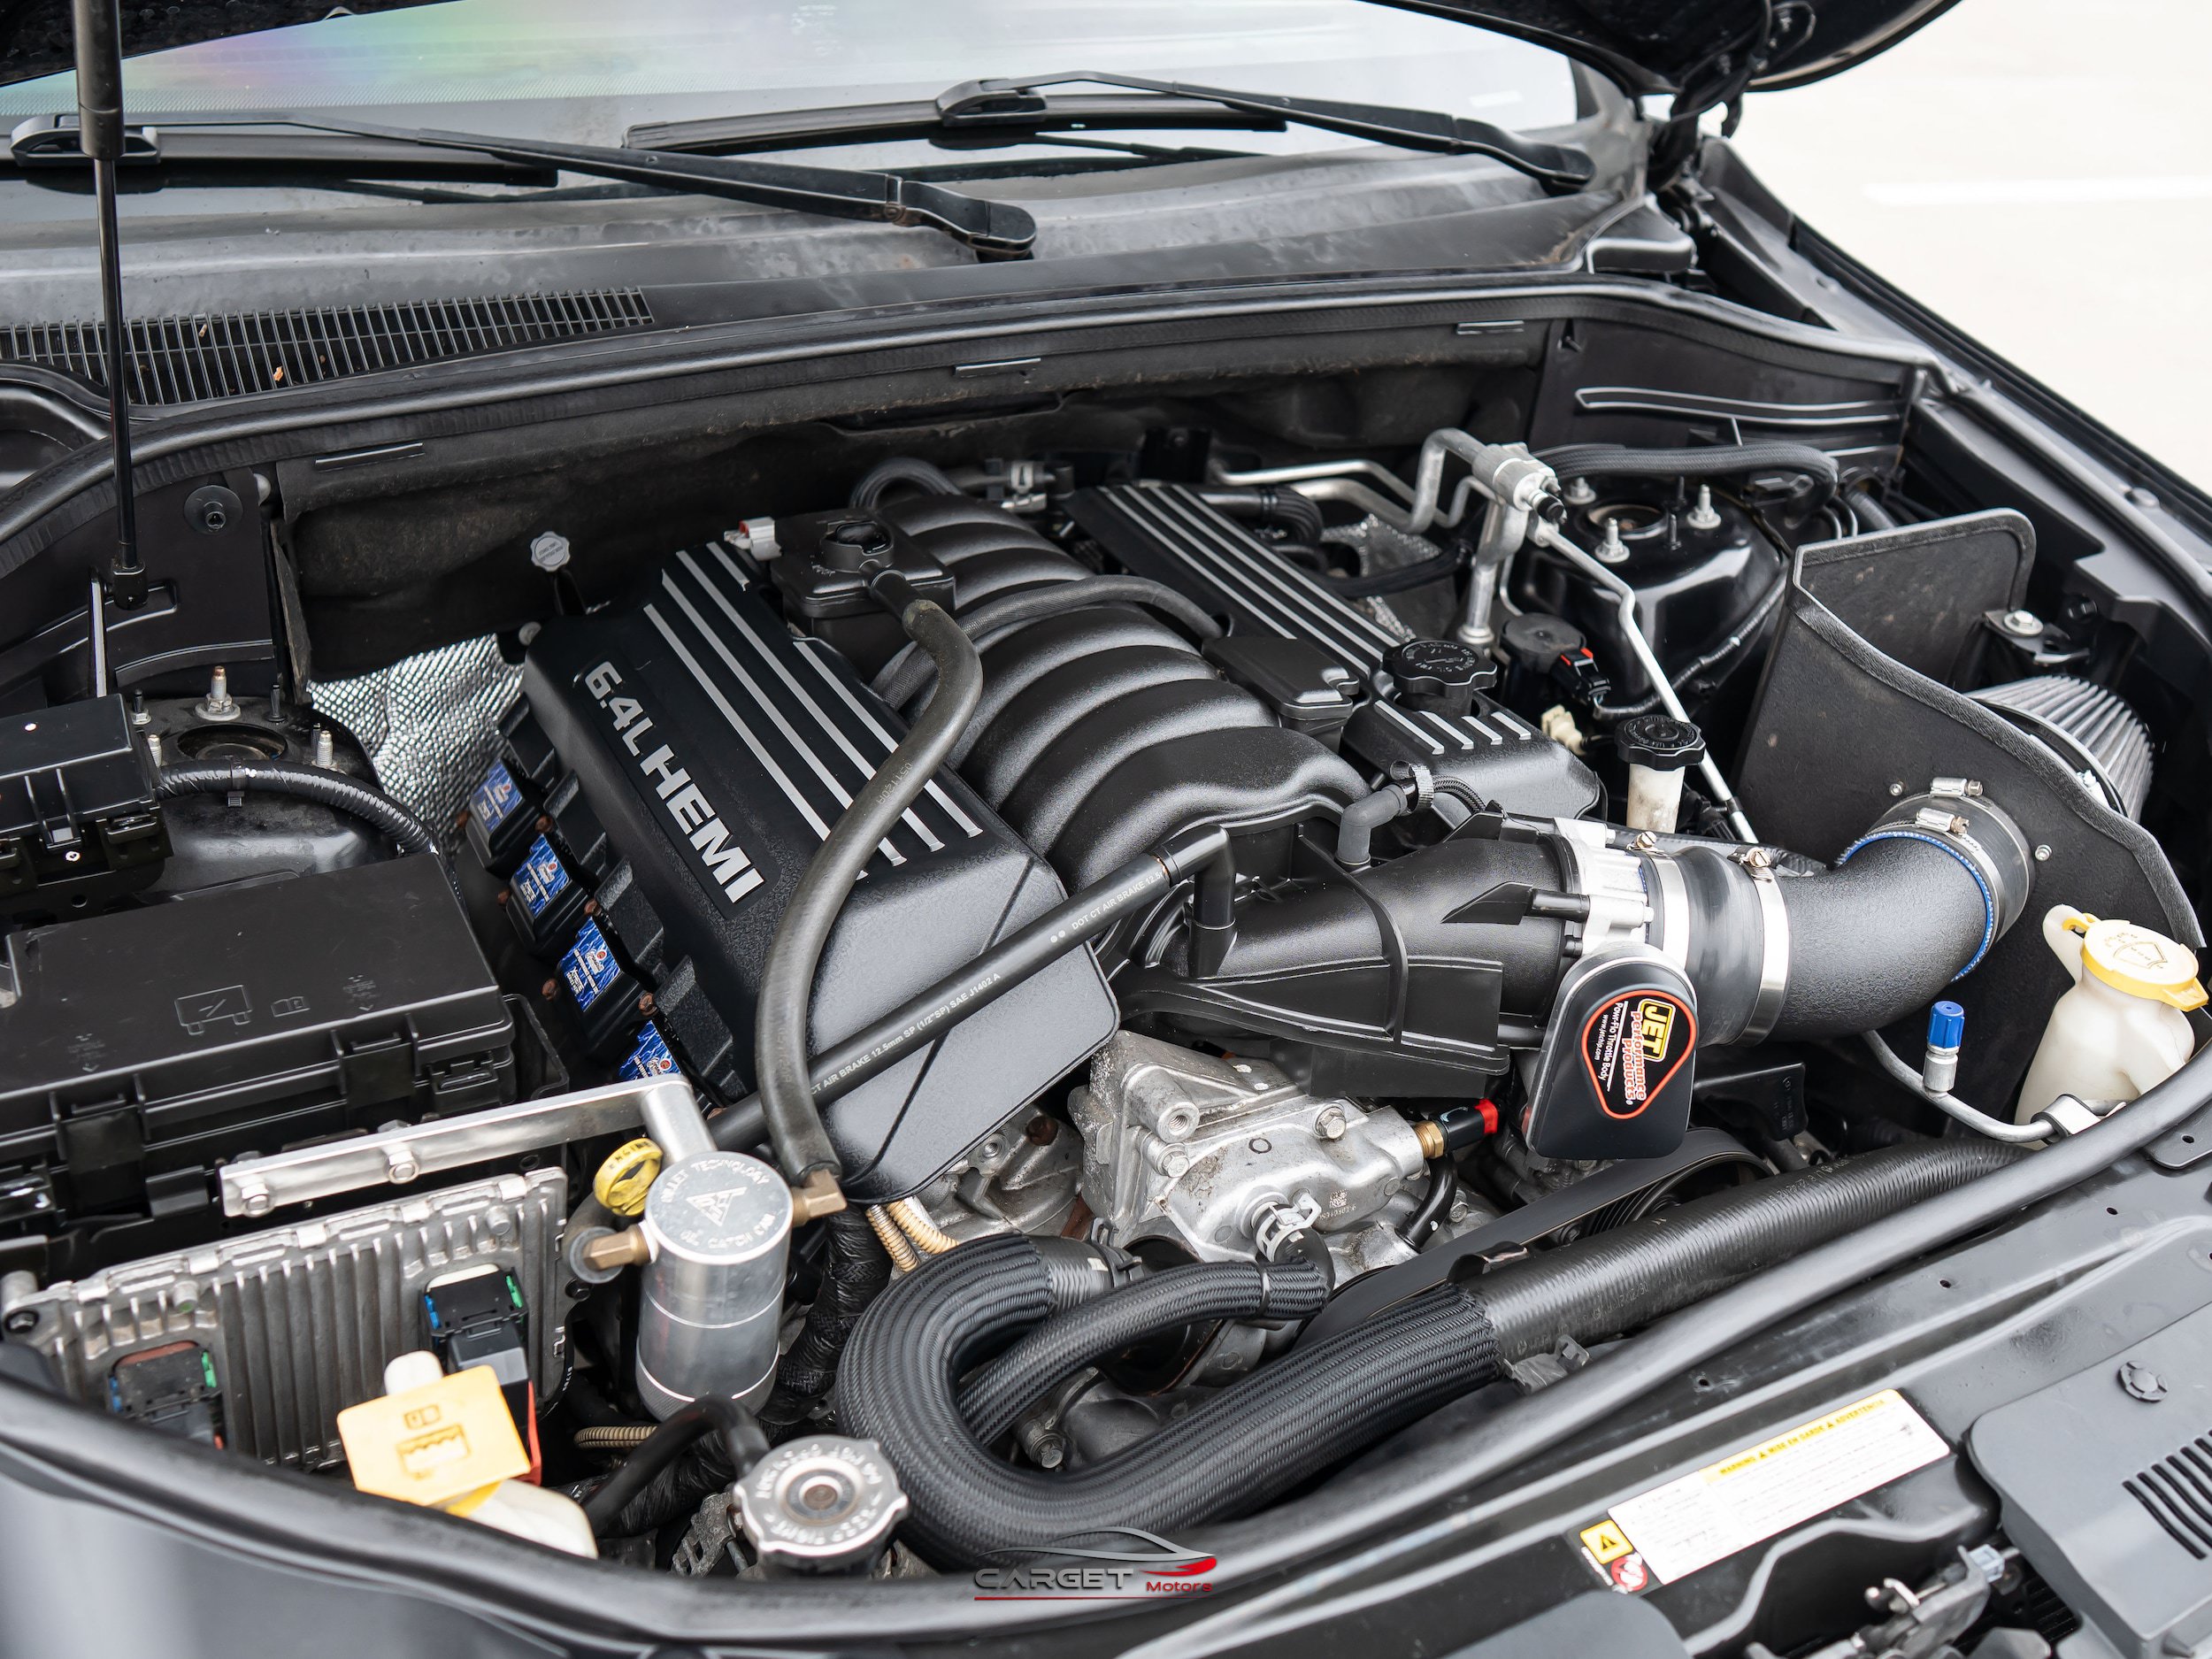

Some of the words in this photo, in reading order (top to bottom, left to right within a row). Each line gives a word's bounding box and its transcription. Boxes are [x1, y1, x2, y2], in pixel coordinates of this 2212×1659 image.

[585, 661, 653, 757] 6.4L
[640, 744, 764, 902] HEMI
[821, 1072, 839, 1087] AIR
[838, 1053, 872, 1078] BRAKE
[870, 1033, 903, 1058] 12.5mm
[902, 1025, 917, 1038] SP
[949, 992, 969, 1008] SAE
[966, 977, 993, 996] J1402
[991, 972, 1001, 981] A
[1071, 914, 1090, 930] DOT
[1088, 906, 1102, 918] CT
[1101, 897, 1118, 911] AIR
[1116, 880, 1146, 902] BRAKE
[1602, 1033, 1616, 1062] Throttle
[1642, 1005, 1668, 1056] JET
[1597, 1061, 1610, 1080] Body
[708, 1233, 753, 1249] CATCH
